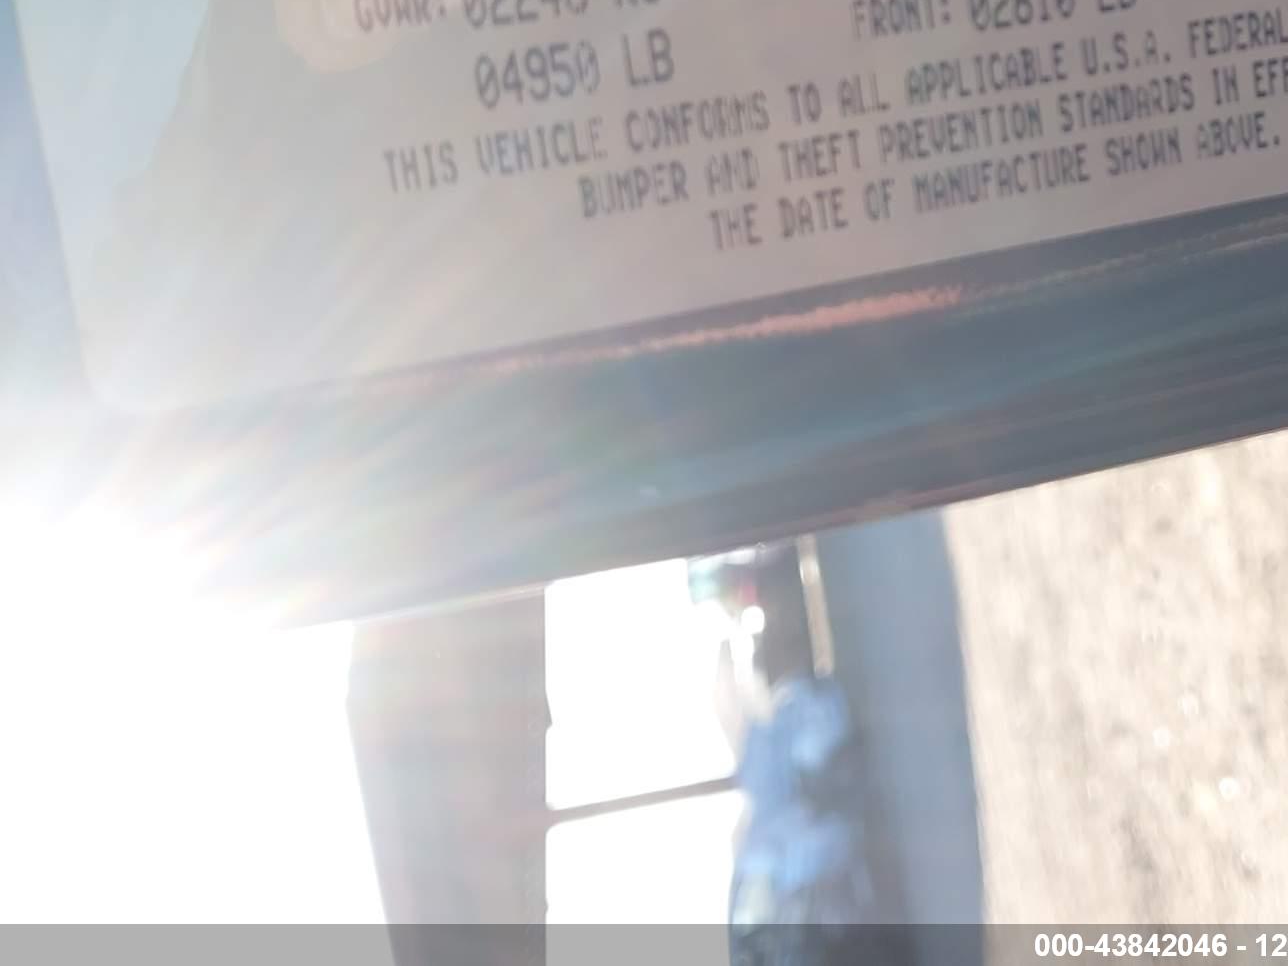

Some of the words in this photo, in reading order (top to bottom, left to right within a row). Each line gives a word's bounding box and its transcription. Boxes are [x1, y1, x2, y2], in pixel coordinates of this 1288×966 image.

[383, 141, 460, 194] THIS
[476, 118, 607, 177] VEHICLE
[624, 90, 772, 155] CONFORMS
[786, 82, 823, 126] TO
[836, 70, 892, 118] ALL
[905, 40, 1069, 108] APPLICABLE
[1079, 30, 1172, 78] U.S.A.
[474, 40, 601, 110] 04950
[620, 28, 676, 89] LB
[577, 162, 690, 220] BUMPER
[704, 145, 762, 200] AND
[777, 128, 863, 183] THEFT
[877, 99, 1045, 164] PREVENTION
[1057, 73, 1196, 134] STANDARDS
[1211, 64, 1241, 107] IN
[708, 202, 764, 252] THE
[778, 186, 850, 240] DATE
[863, 177, 896, 222] OF
[913, 142, 1091, 215] MANUFACTURE
[1104, 126, 1184, 178] SHOWN
[1197, 111, 1281, 161] ABOVE.
